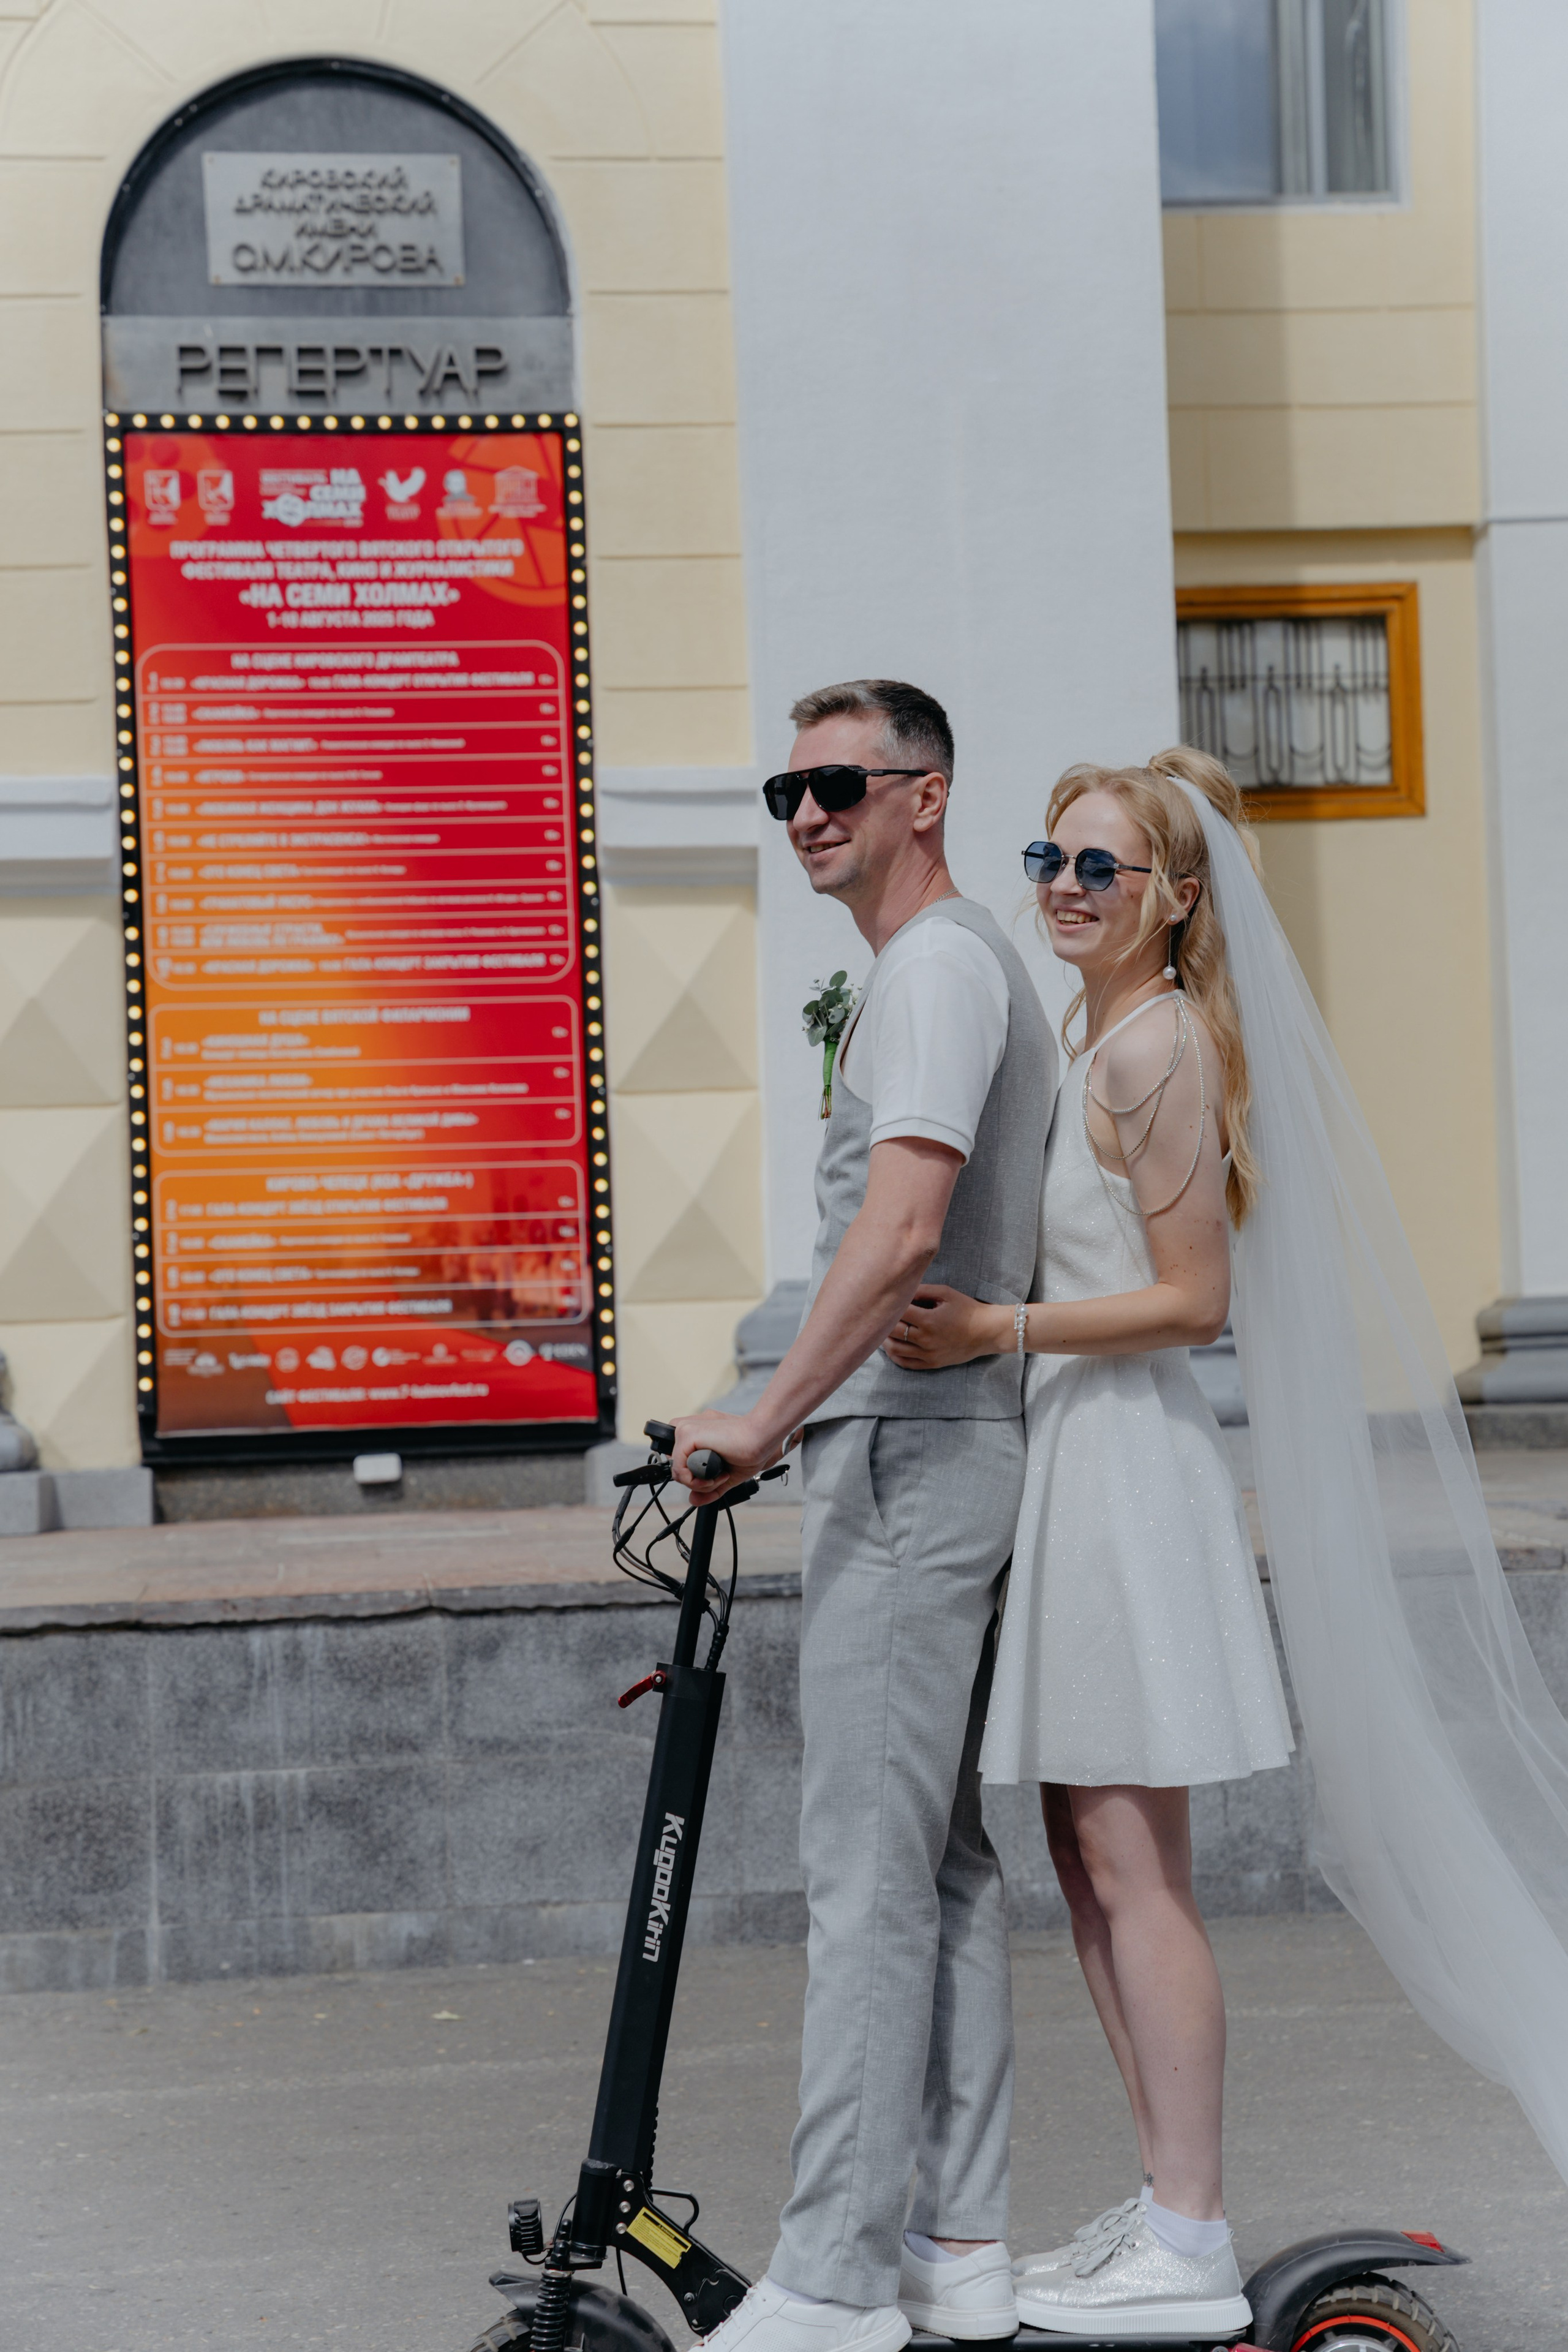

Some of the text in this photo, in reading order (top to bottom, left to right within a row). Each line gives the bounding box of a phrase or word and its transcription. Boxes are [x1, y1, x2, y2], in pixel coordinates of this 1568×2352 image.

[260, 167, 409, 192] КИРОВСКИЙ
[176, 344, 509, 402] РЕПЕРТУАР
[285, 582, 351, 608] СЕМИ
